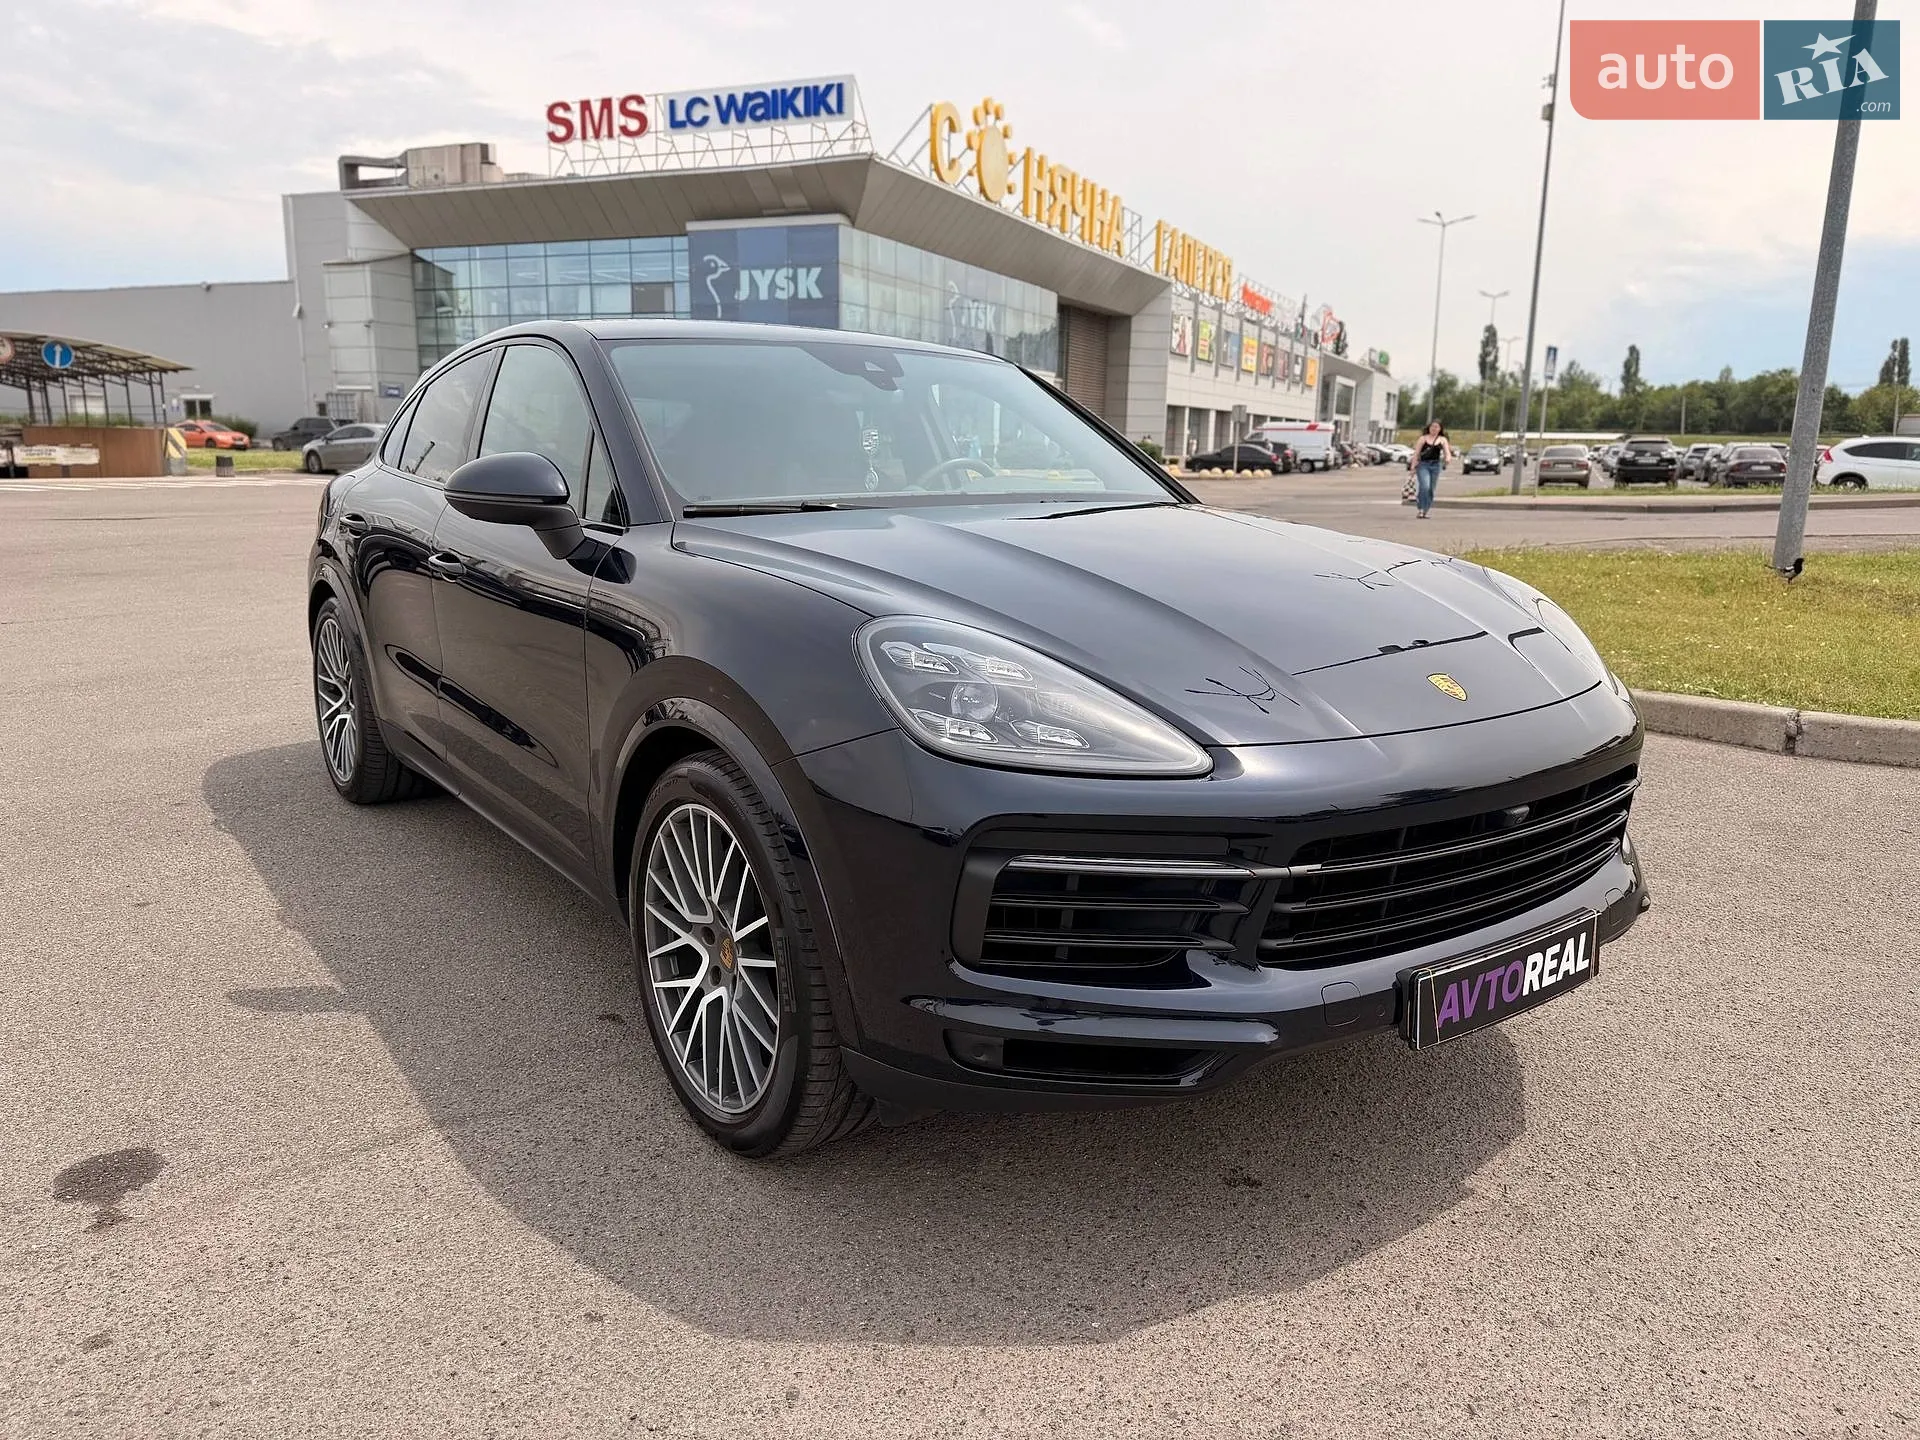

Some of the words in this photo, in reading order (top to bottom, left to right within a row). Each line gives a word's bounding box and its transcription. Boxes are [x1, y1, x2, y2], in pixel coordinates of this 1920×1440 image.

[546, 93, 649, 145] SMS
[668, 97, 710, 129] LC
[734, 266, 823, 301] JYSK
[1155, 218, 1234, 303] ГАЛЕРЕЯ
[1438, 932, 1590, 1028] AVTOREAL
